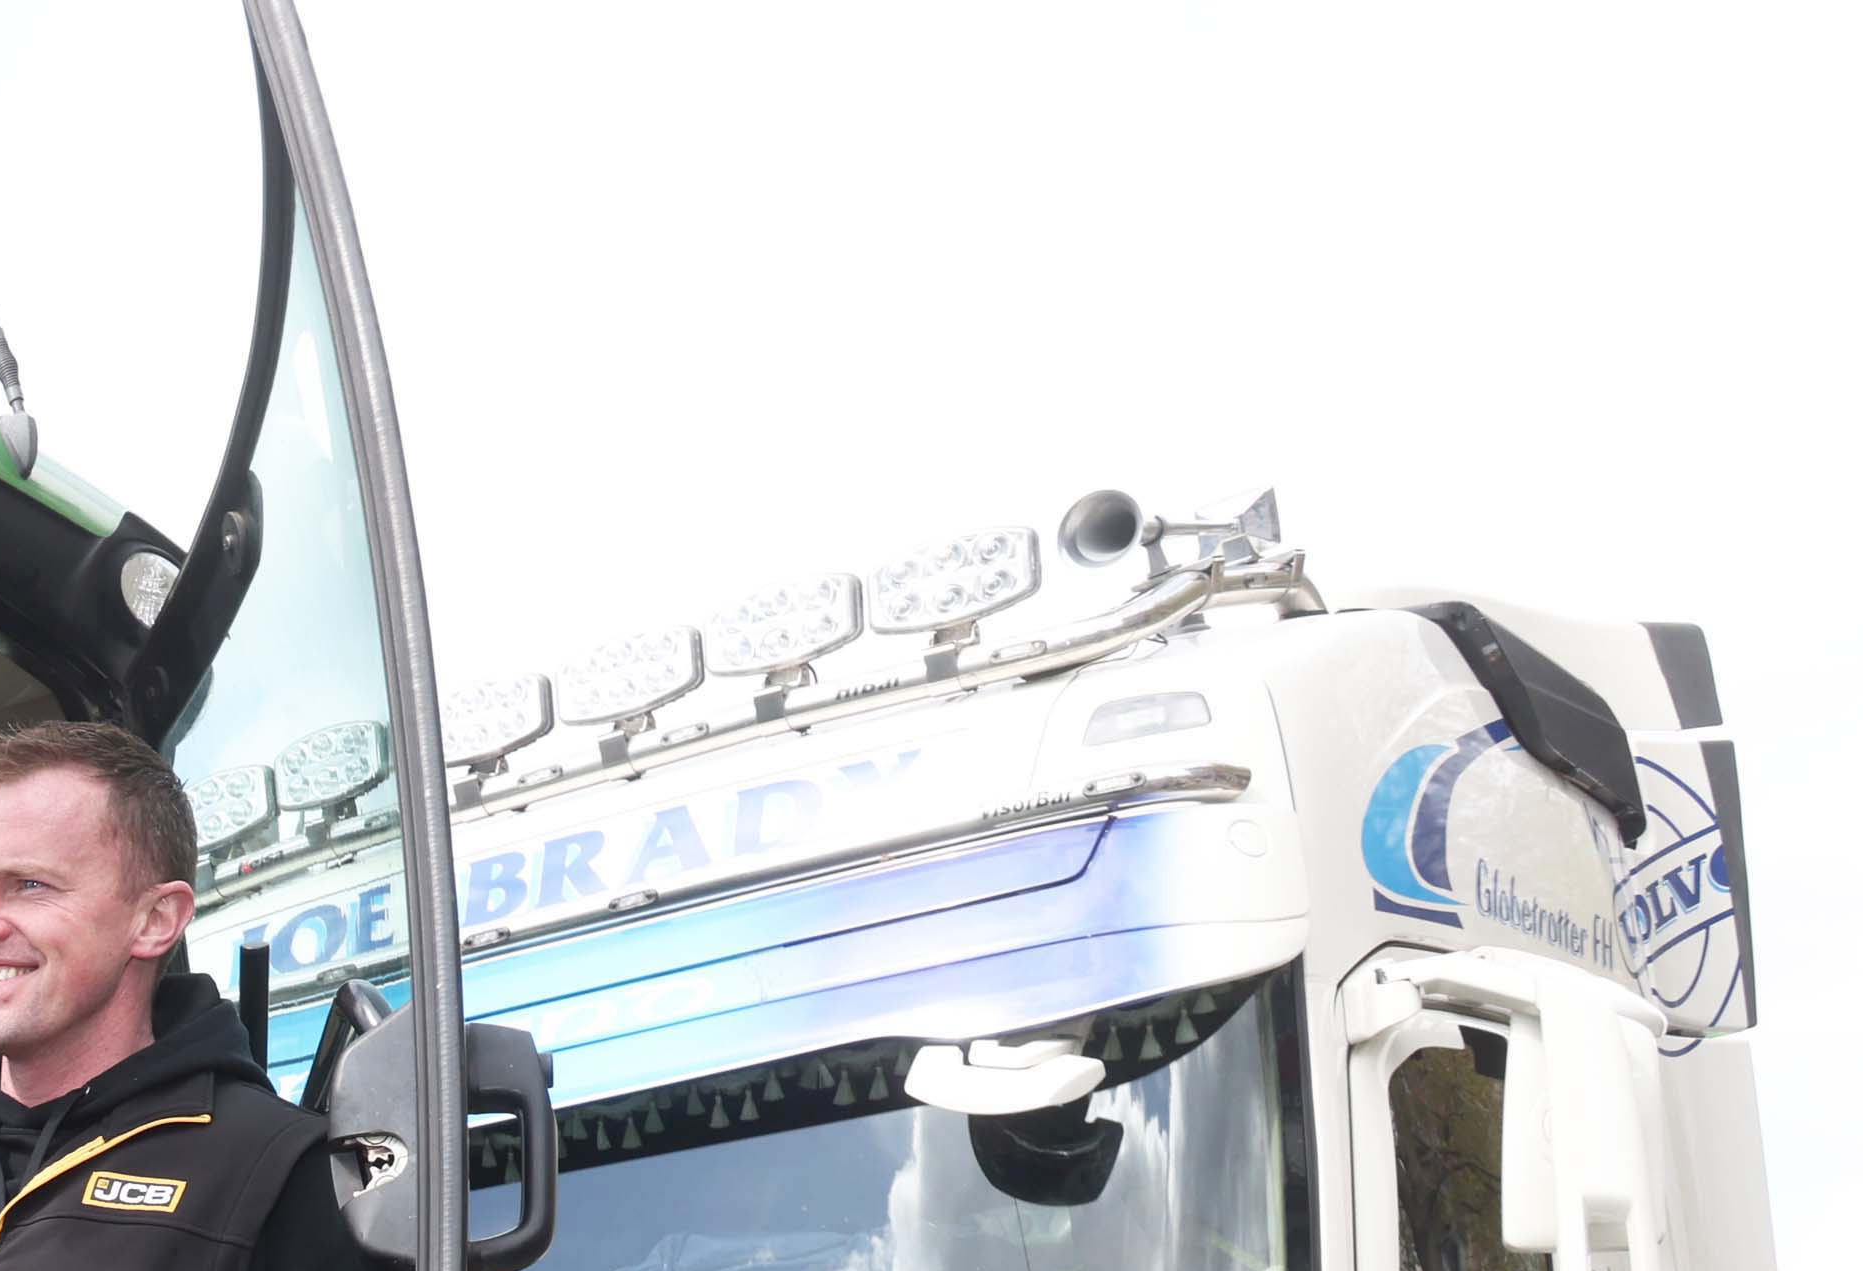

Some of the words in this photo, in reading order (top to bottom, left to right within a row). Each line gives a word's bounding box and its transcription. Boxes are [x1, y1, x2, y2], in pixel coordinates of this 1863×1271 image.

[1475, 857, 1589, 956] Globetrotter
[1592, 912, 1615, 970] FH
[94, 1181, 174, 1205] JCB
